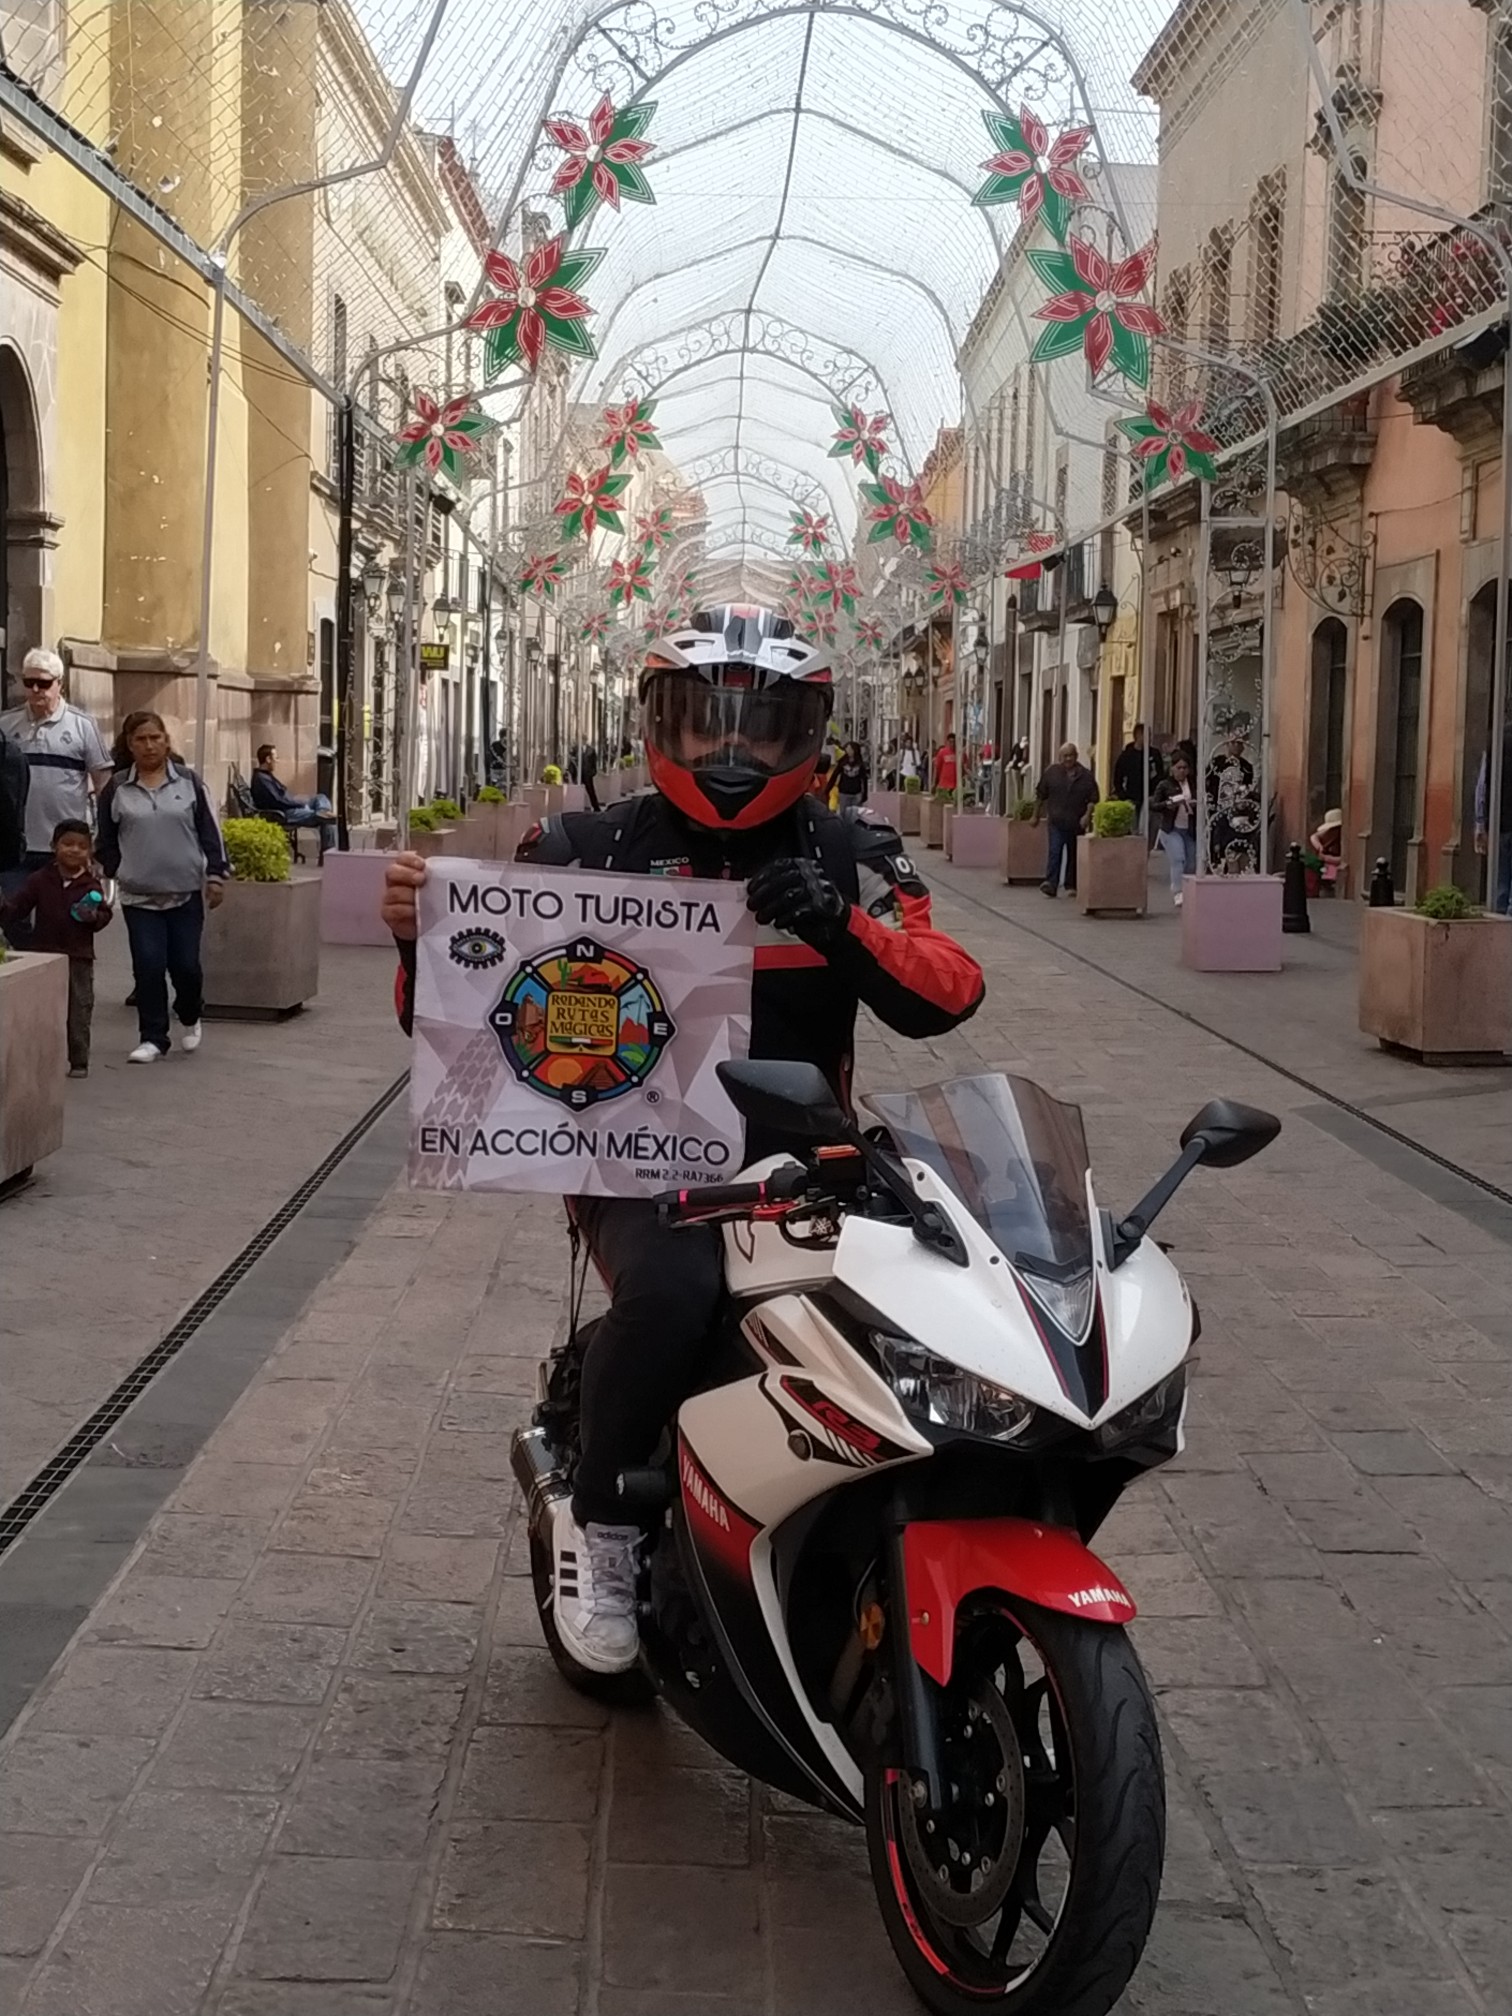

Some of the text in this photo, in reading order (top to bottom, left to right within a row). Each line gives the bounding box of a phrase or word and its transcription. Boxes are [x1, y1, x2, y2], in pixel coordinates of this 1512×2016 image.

[650, 857, 690, 867] MEXICO
[448, 881, 721, 934] MOTO TURISTA
[576, 944, 595, 958] N
[653, 1022, 668, 1036] E
[570, 1090, 587, 1103] S
[420, 1121, 730, 1166] EN ACCIÓN MÉXICO
[635, 1167, 661, 1180] RRM
[682, 1454, 731, 1533] YAMAHA
[1067, 1588, 1133, 1610] YAMAHA
